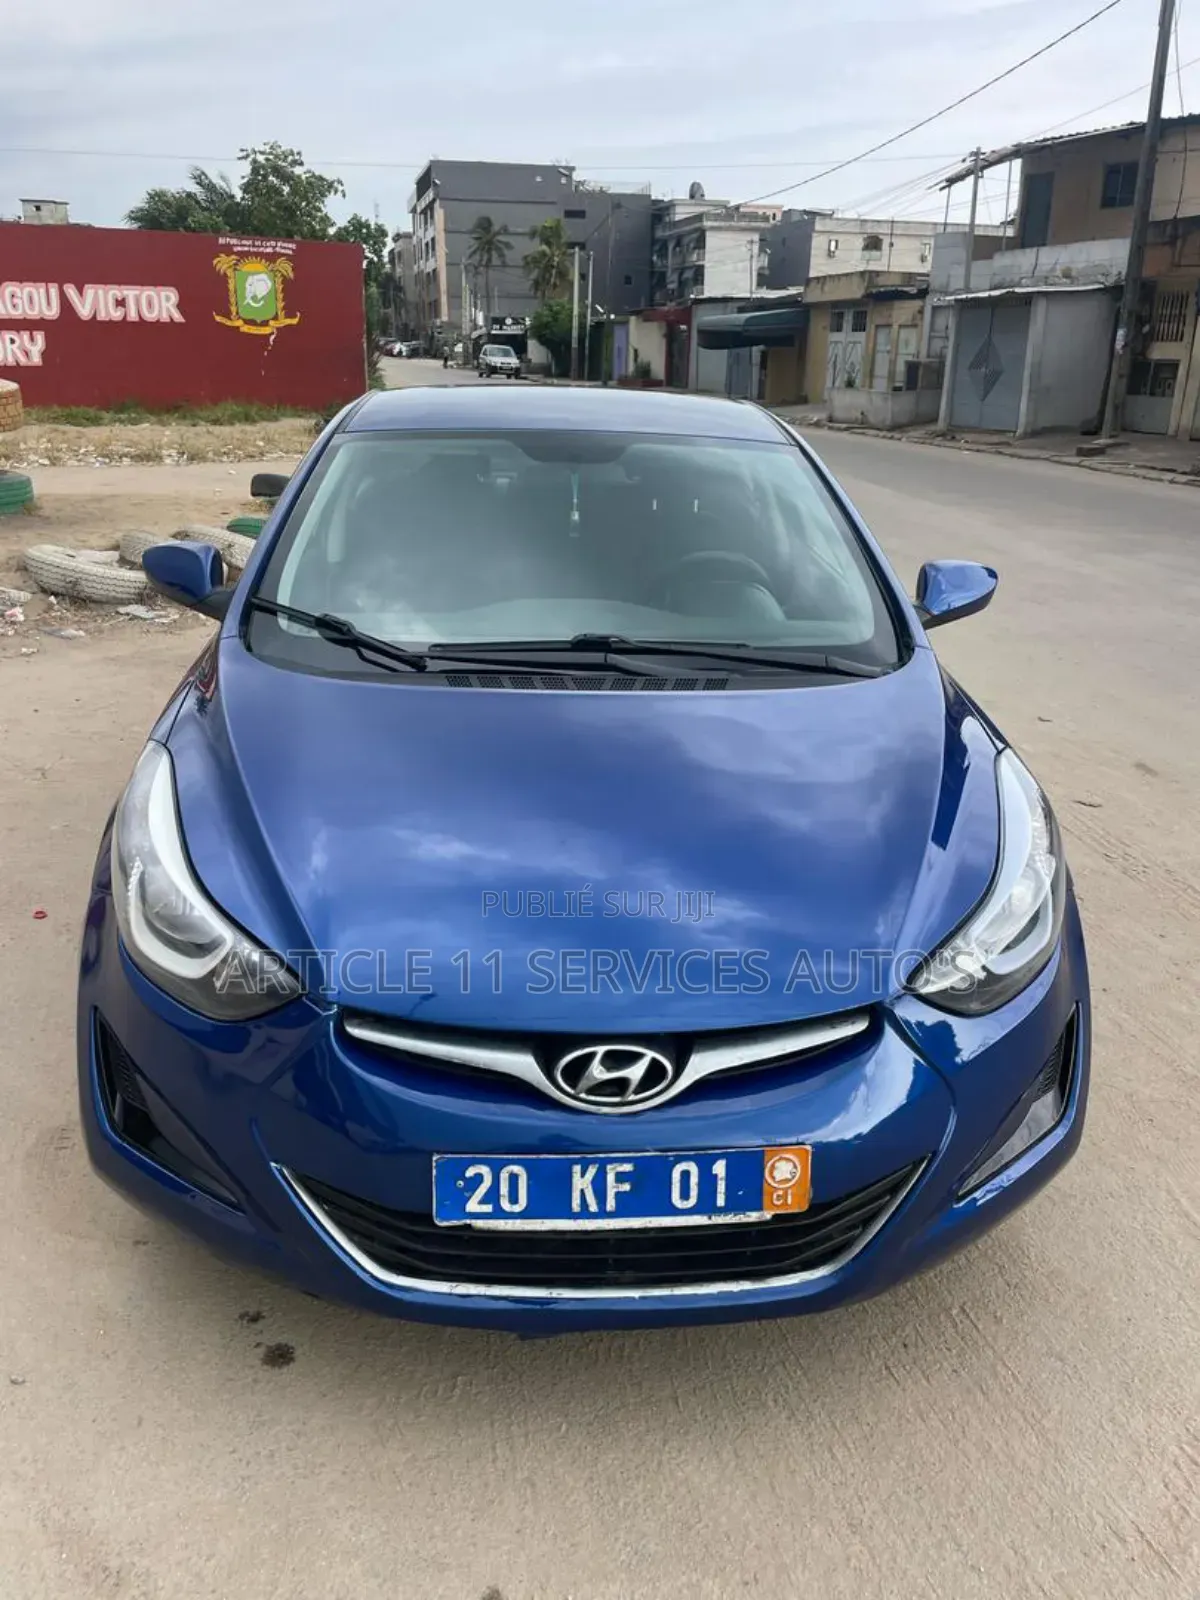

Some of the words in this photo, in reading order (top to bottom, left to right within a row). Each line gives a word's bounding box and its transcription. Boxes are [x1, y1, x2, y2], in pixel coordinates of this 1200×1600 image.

[0, 281, 60, 320] GOU
[63, 283, 186, 322] VICTOR
[0, 330, 46, 366] RY
[464, 1164, 528, 1213] 20
[571, 1163, 635, 1213] KF
[670, 1158, 728, 1209] 01
[772, 1188, 793, 1206] CI
